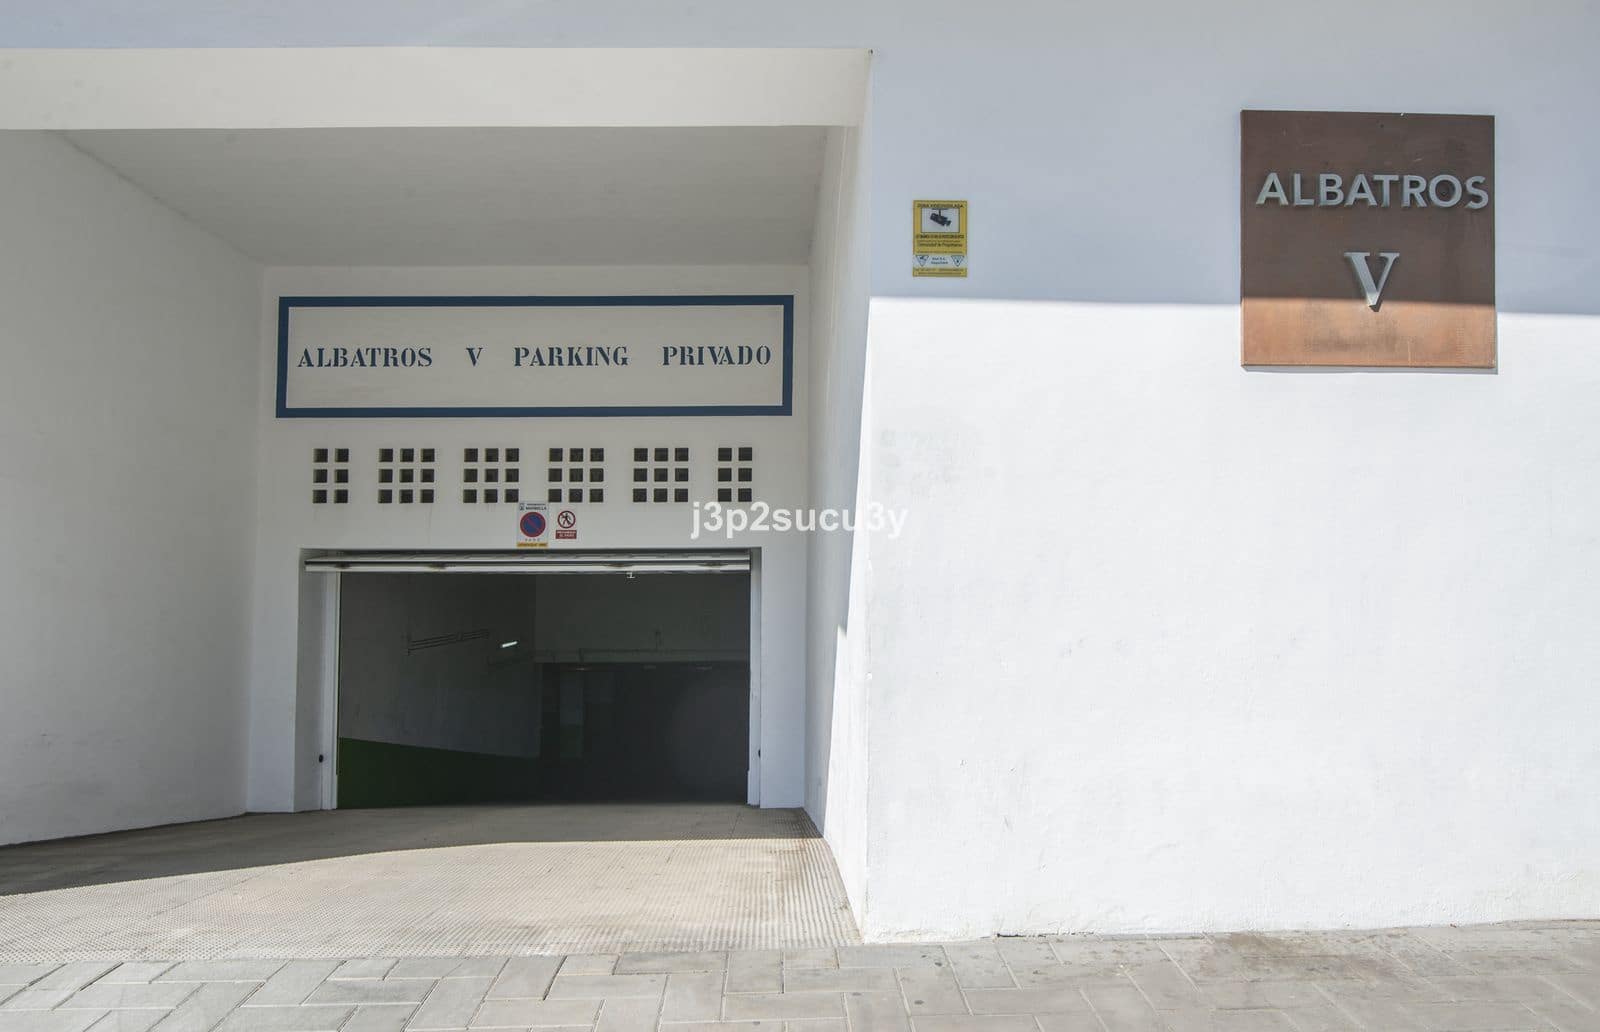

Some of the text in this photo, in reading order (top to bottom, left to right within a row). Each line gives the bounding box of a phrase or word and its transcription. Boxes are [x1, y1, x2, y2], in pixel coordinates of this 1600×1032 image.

[1256, 173, 1489, 209] ALBATROS
[1344, 252, 1400, 307] V
[297, 345, 772, 368] ALBATROS V PARKING PRIVADO
